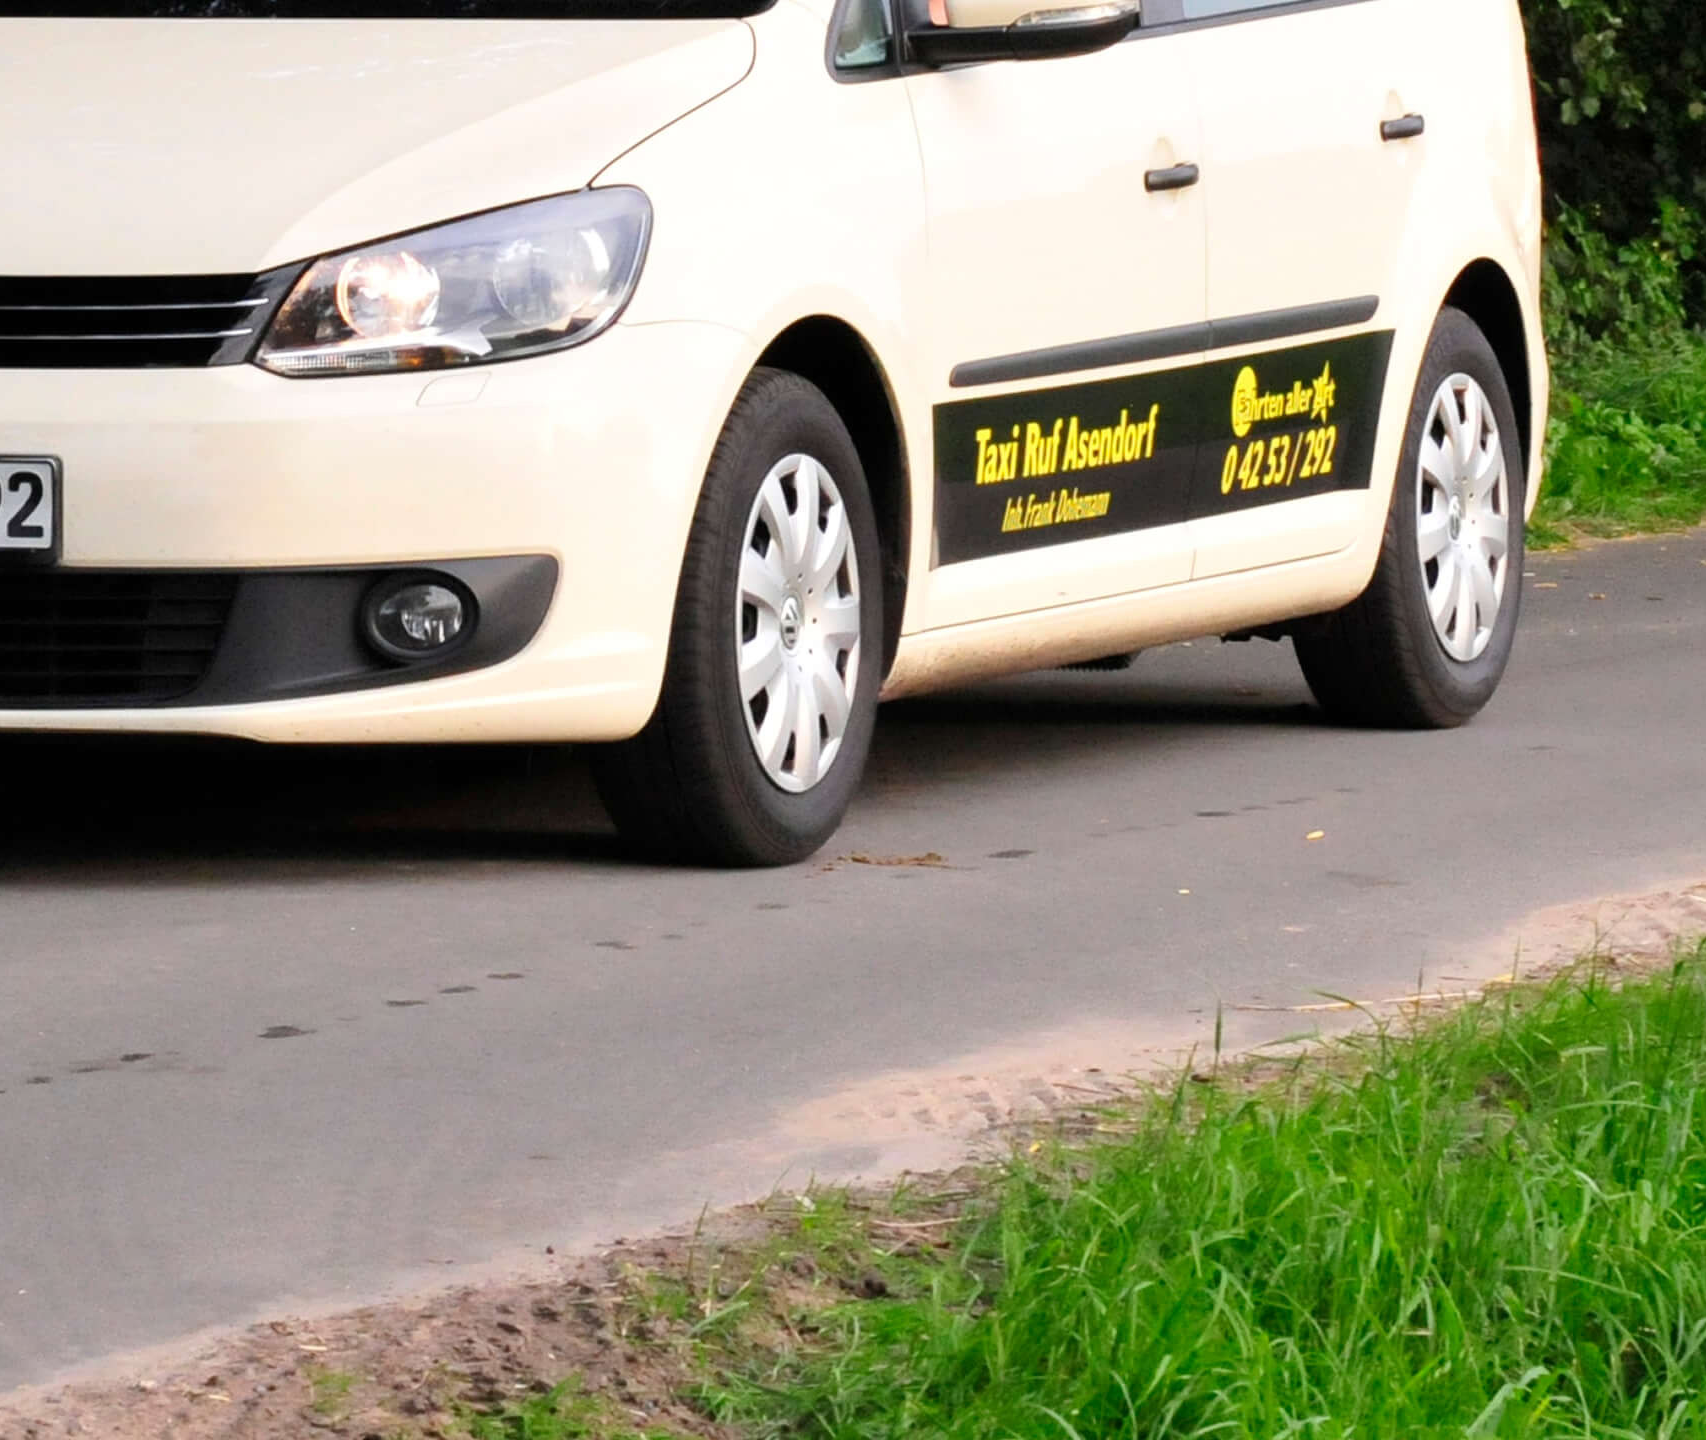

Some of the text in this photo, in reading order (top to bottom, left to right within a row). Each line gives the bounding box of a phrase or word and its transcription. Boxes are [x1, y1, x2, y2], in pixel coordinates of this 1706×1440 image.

[1285, 380, 1314, 416] aller
[975, 403, 1160, 485] Taxi Ruf Asendorf
[1221, 444, 1238, 495] 0
[1237, 439, 1265, 490] 42
[1262, 434, 1291, 486] 53
[1299, 424, 1337, 479] 292
